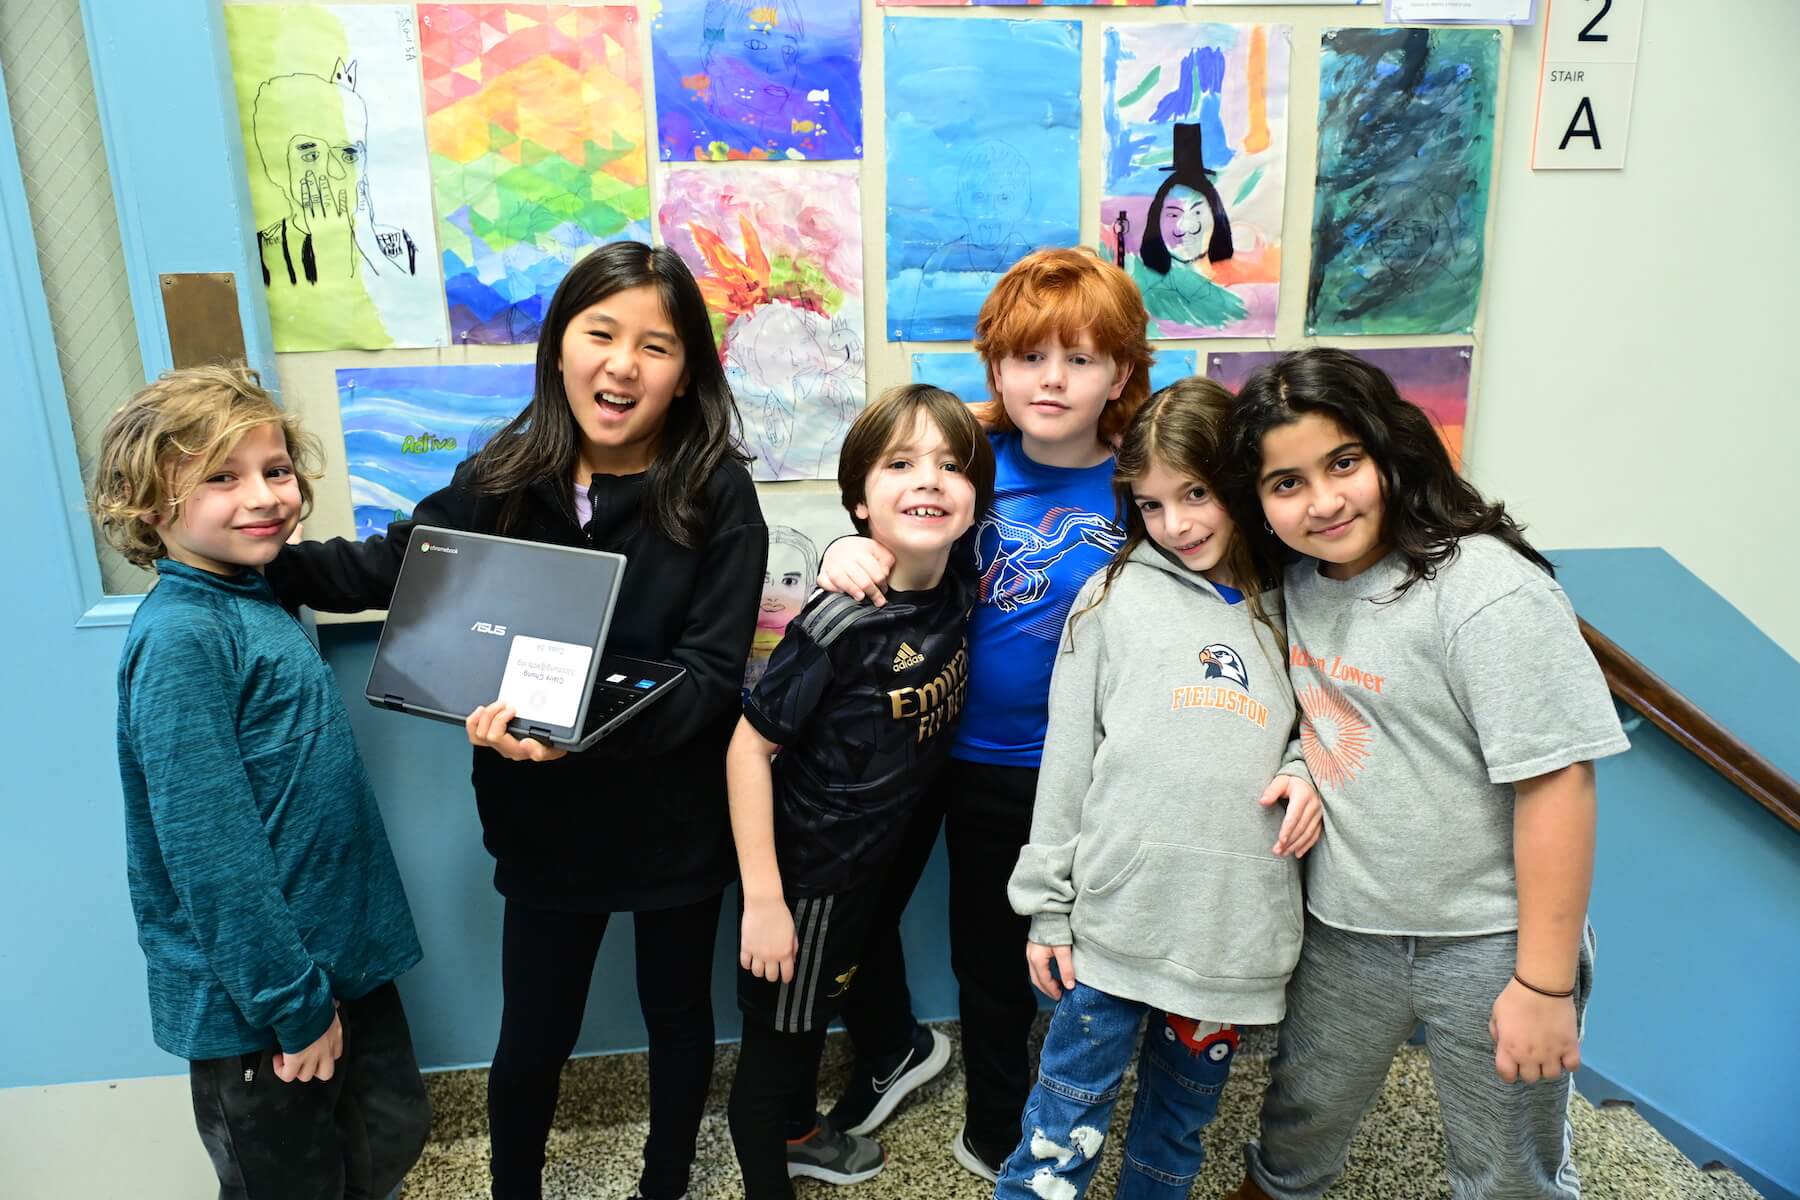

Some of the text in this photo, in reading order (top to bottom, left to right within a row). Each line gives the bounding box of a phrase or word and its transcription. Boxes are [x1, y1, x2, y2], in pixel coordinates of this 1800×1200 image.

[1578, 0, 1613, 42] 2
[1551, 70, 1585, 82] STAIR
[1558, 96, 1602, 149] A
[402, 432, 456, 454] Active
[471, 621, 507, 636] ASUS
[892, 653, 925, 673] adidas
[1331, 656, 1385, 693] Lower
[1171, 684, 1269, 731] FIELDSTON
